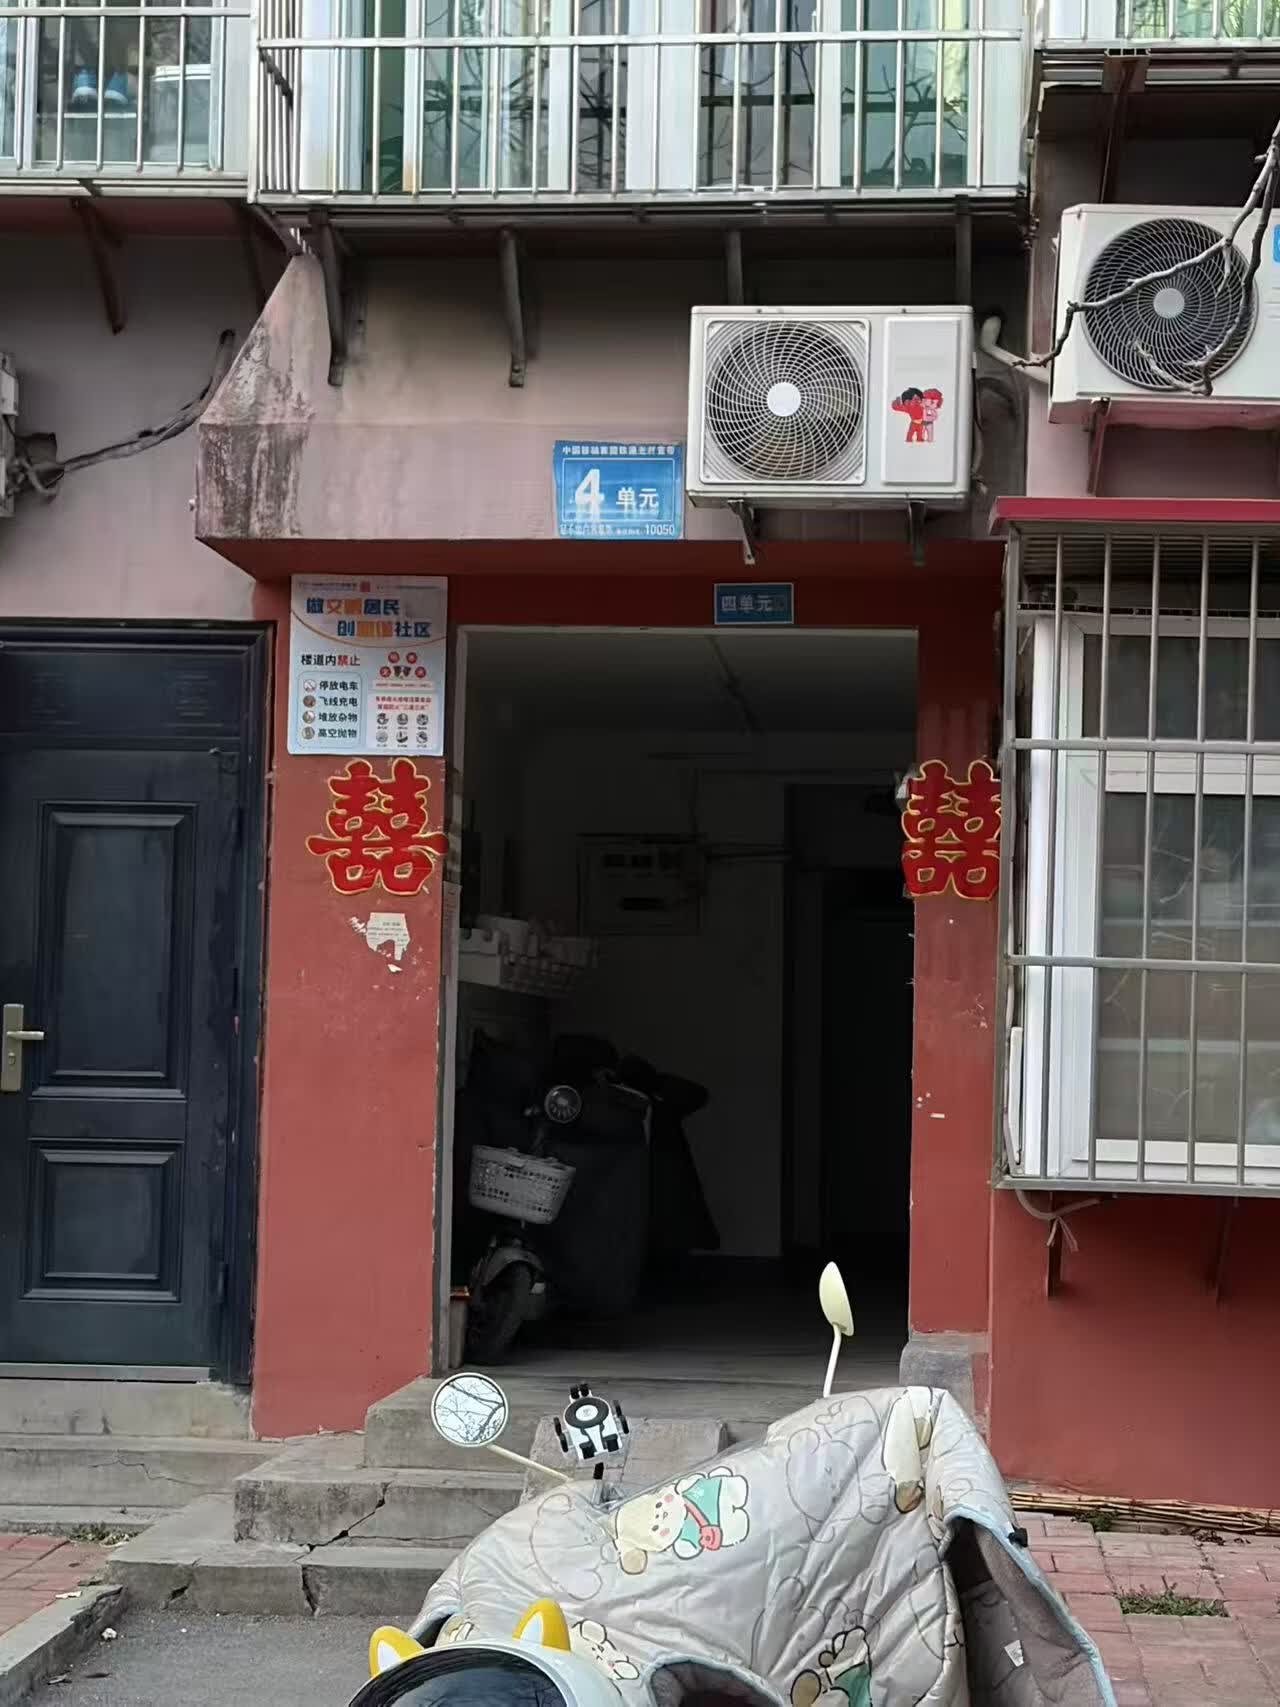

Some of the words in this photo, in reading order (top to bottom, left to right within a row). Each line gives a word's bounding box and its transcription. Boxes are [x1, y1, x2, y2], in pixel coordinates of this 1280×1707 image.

[574, 468, 605, 516] 4
[616, 486, 659, 515] 单元
[645, 524, 675, 536] 10050
[301, 654, 361, 667] 楼道内禁止
[319, 680, 359, 692] 停放电车
